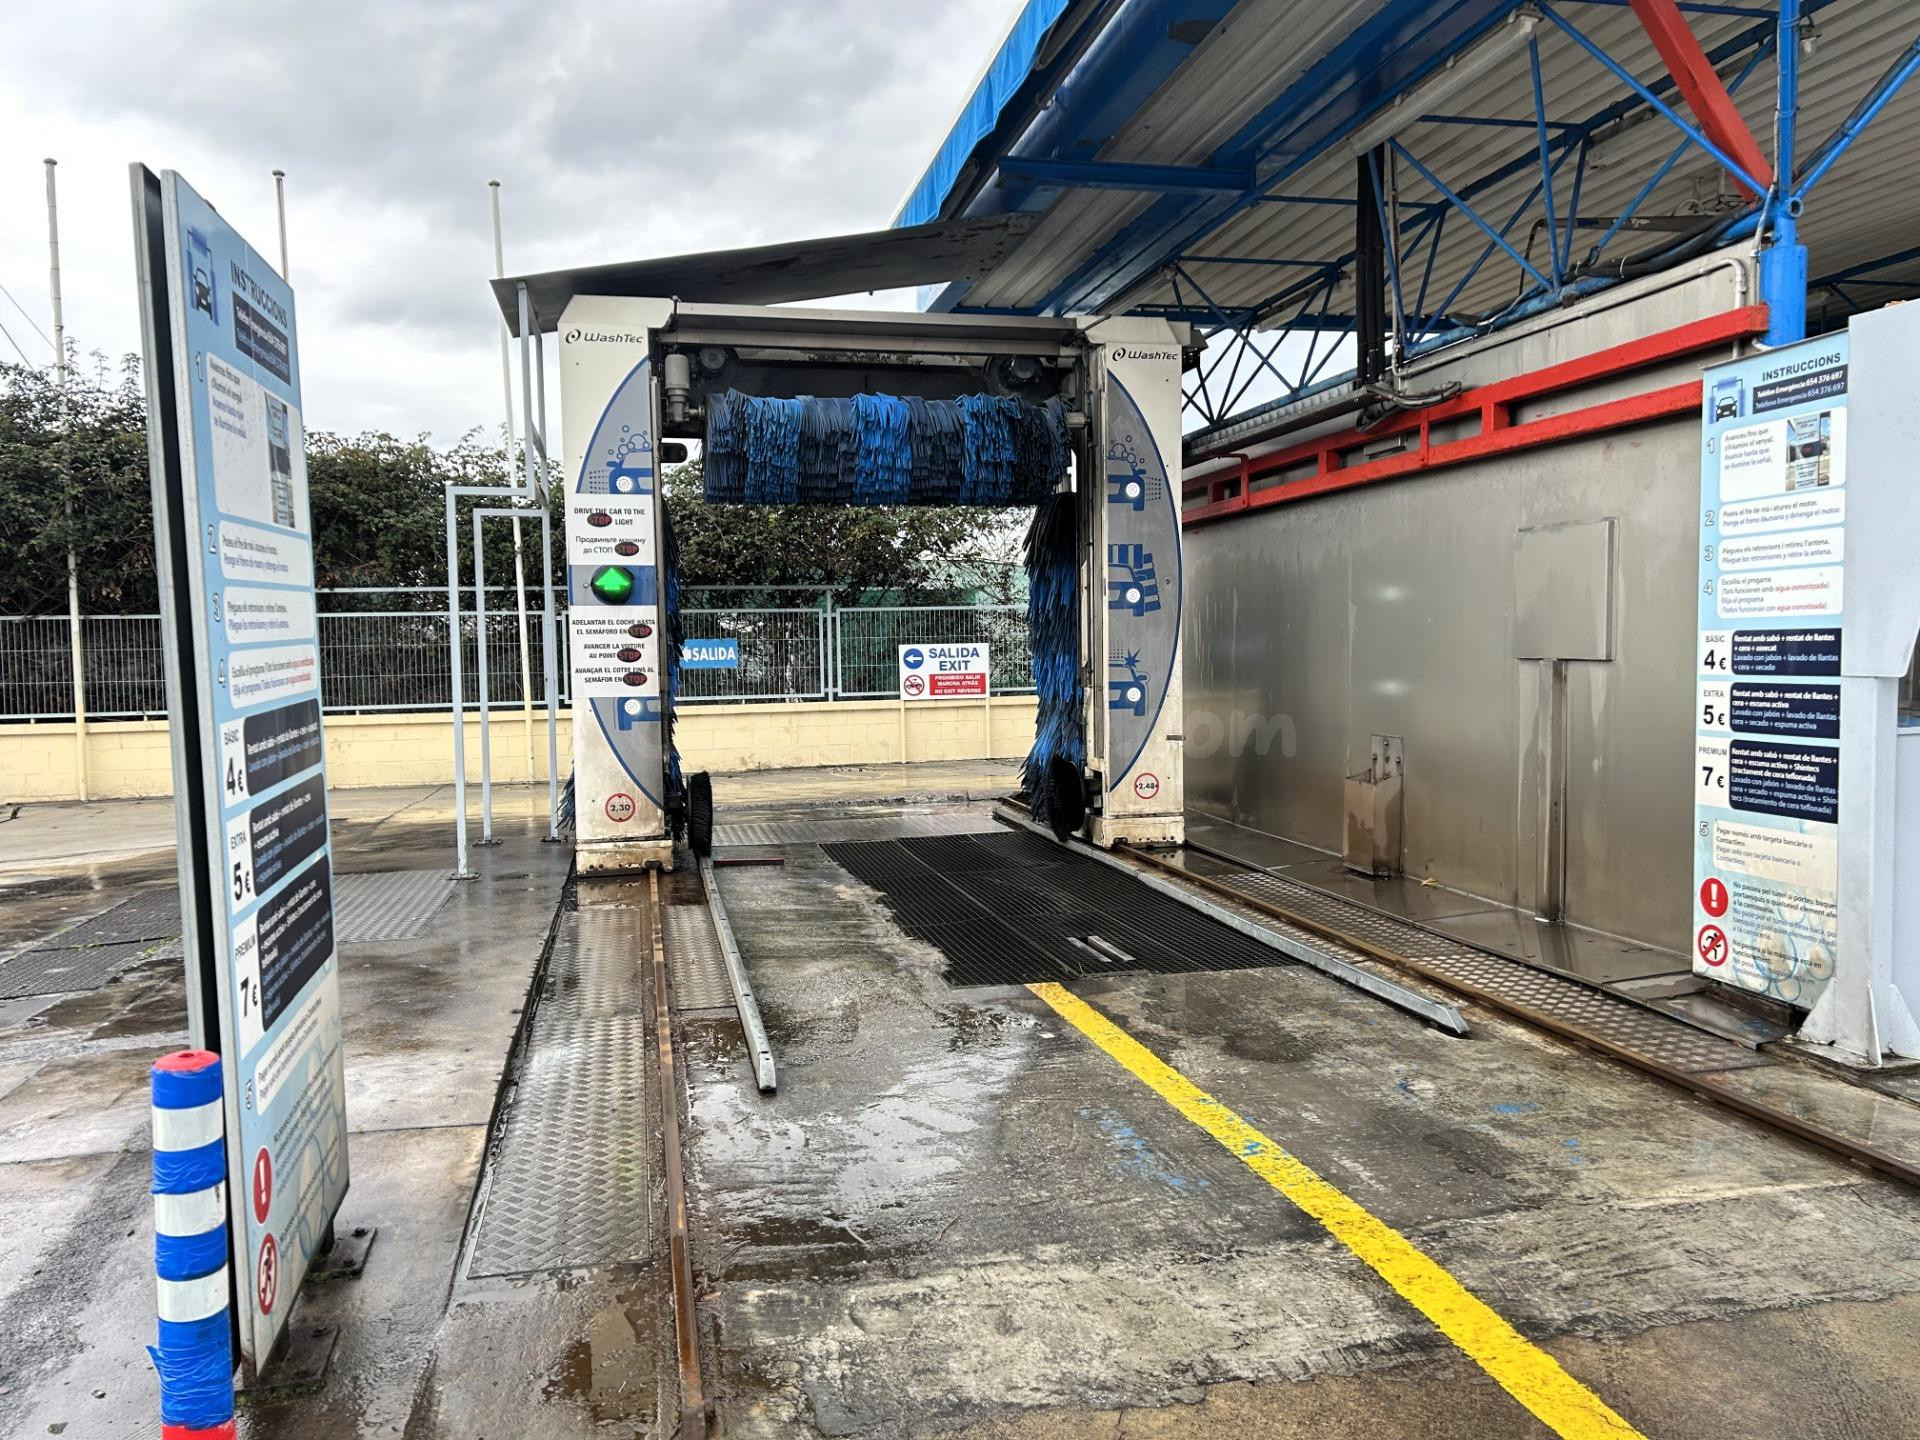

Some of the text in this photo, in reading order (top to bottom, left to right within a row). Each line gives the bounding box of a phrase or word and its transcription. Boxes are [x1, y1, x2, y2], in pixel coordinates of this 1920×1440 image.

[230, 259, 288, 329] INSTRUCCIONS
[584, 332, 644, 344] WashTec
[1127, 350, 1178, 361] WashTec
[1762, 352, 1841, 381] INSTRUCCIONS
[1806, 377, 1817, 386] 654
[1818, 373, 1830, 383] 376
[1831, 370, 1843, 380] 697
[1707, 437, 1715, 454] 1
[588, 516, 611, 525] STOP
[1705, 510, 1714, 527] 2
[208, 524, 217, 555] 2
[1704, 545, 1713, 561] 3
[1703, 579, 1712, 597] 4
[213, 592, 221, 623] 3
[629, 627, 650, 635] STOP
[692, 647, 736, 661] SALIDA
[929, 647, 980, 659] SALIDA
[218, 658, 226, 688] 4
[939, 660, 970, 671] EXIT
[625, 675, 645, 683] STOP
[1704, 689, 1724, 697] EXTRA
[1699, 747, 1727, 756] PREMIUM
[610, 804, 630, 812] 2,30
[1700, 820, 1709, 836] 5
[230, 831, 247, 850] EXTRA
[235, 935, 256, 962] PREMIUM
